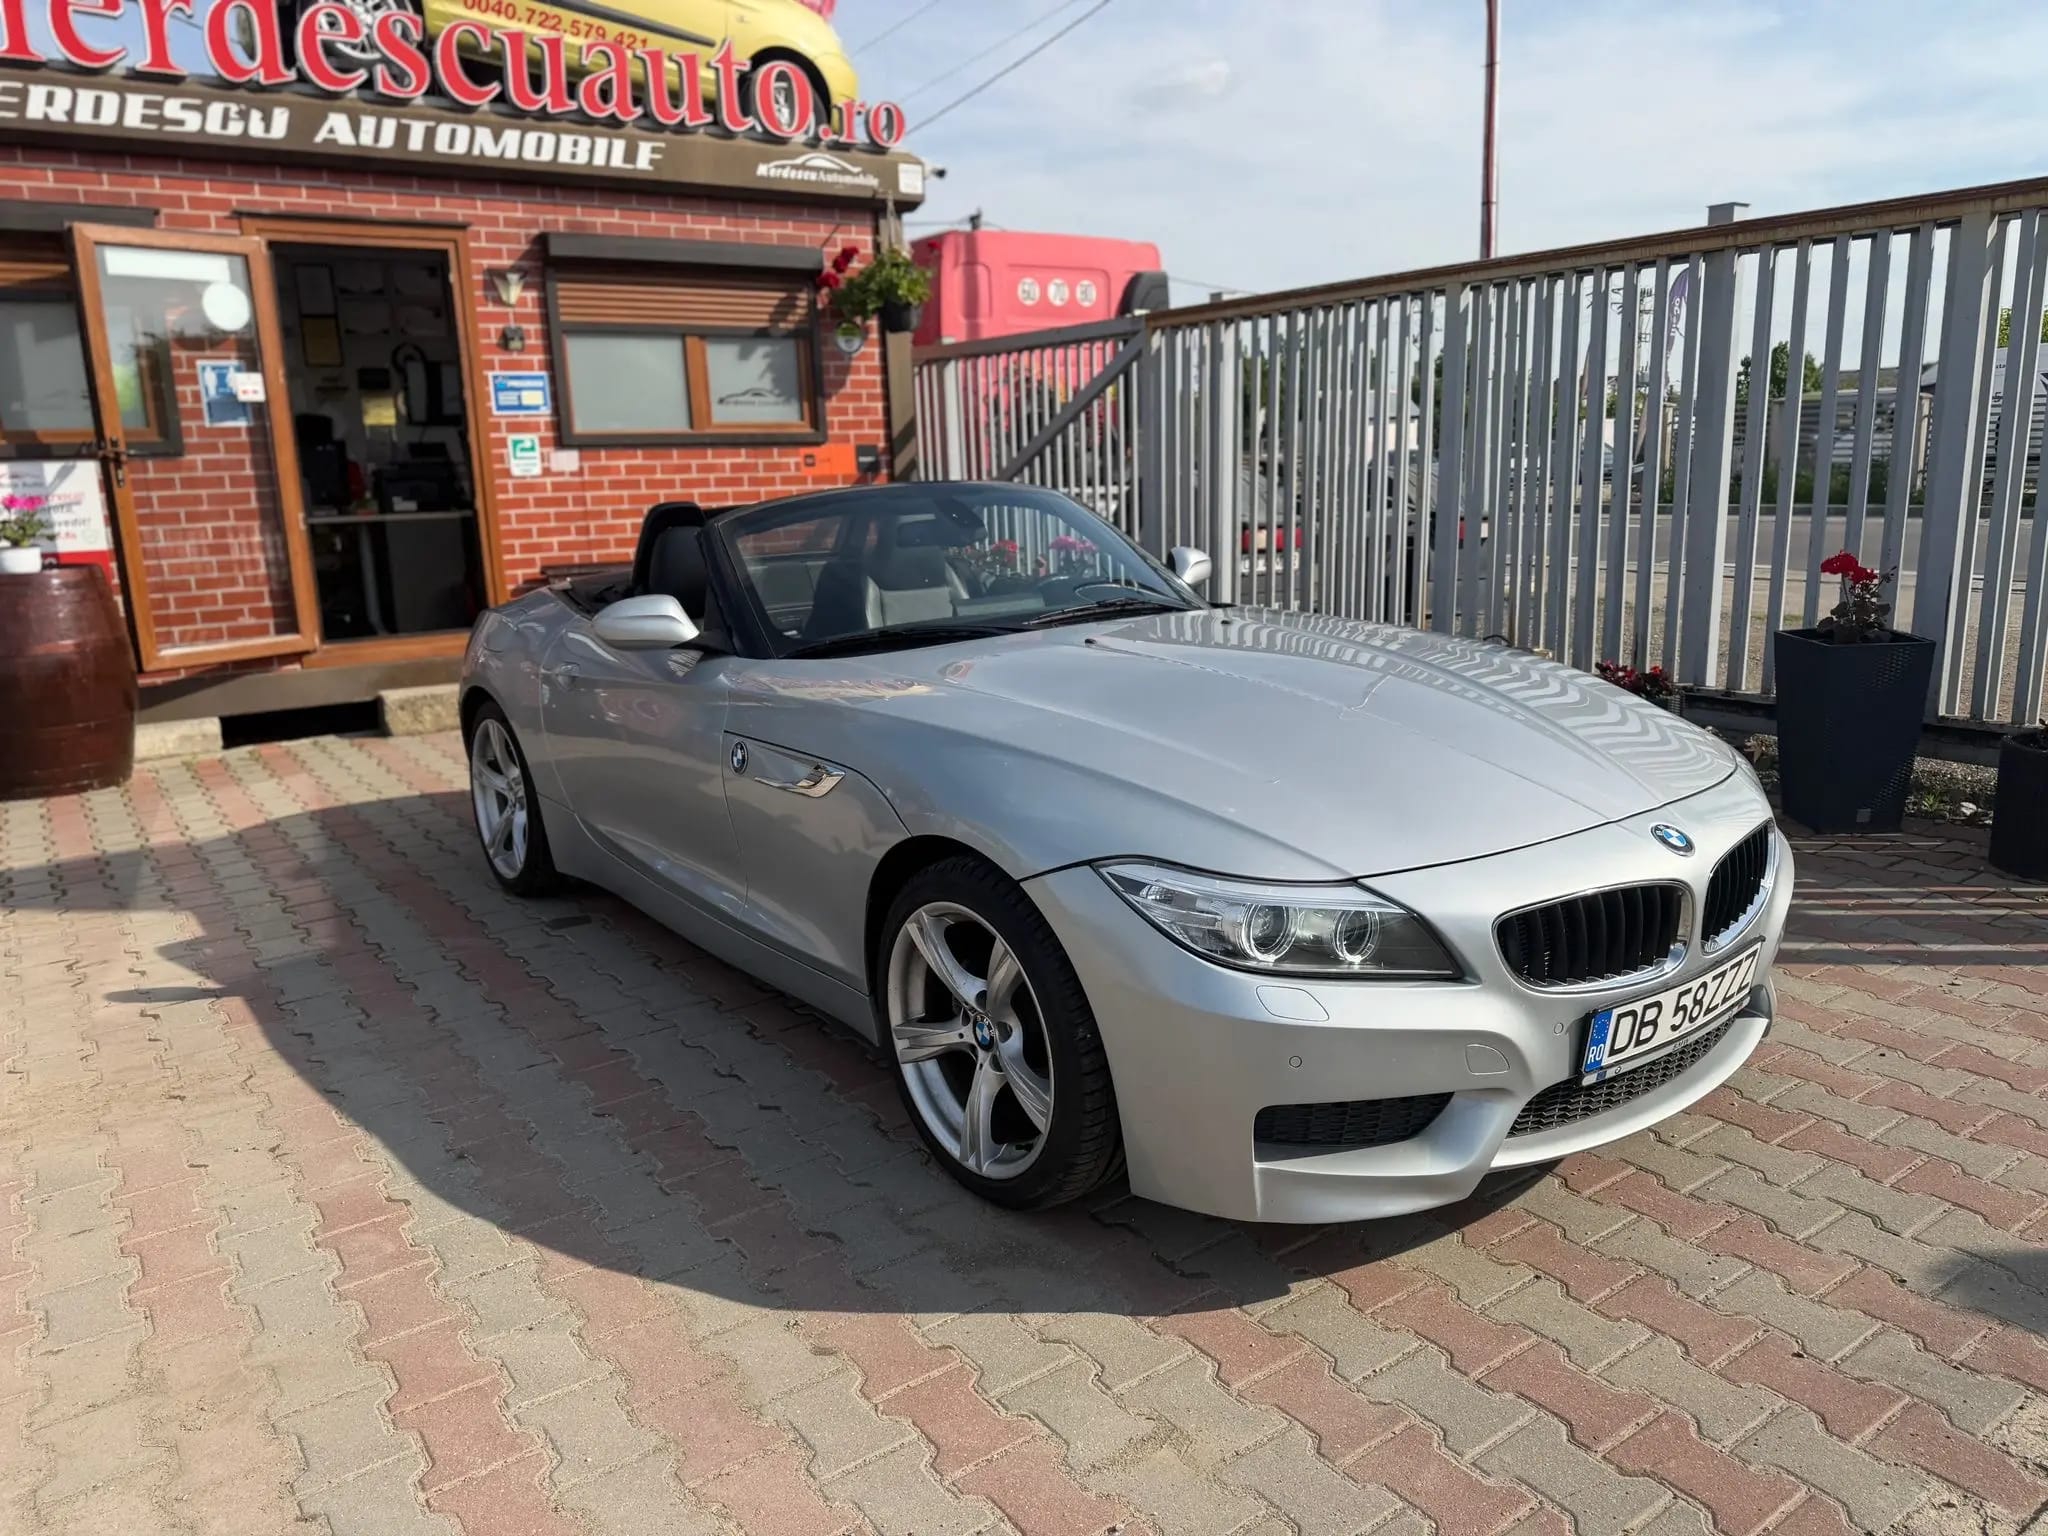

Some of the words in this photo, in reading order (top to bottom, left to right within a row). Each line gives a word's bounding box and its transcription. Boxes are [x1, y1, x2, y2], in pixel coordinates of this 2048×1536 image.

[313, 111, 667, 172] AUTOMOBILE
[1587, 1044, 1604, 1065] RO
[1607, 1000, 1663, 1058] DB
[1670, 948, 1757, 1032] 58ZZZ
